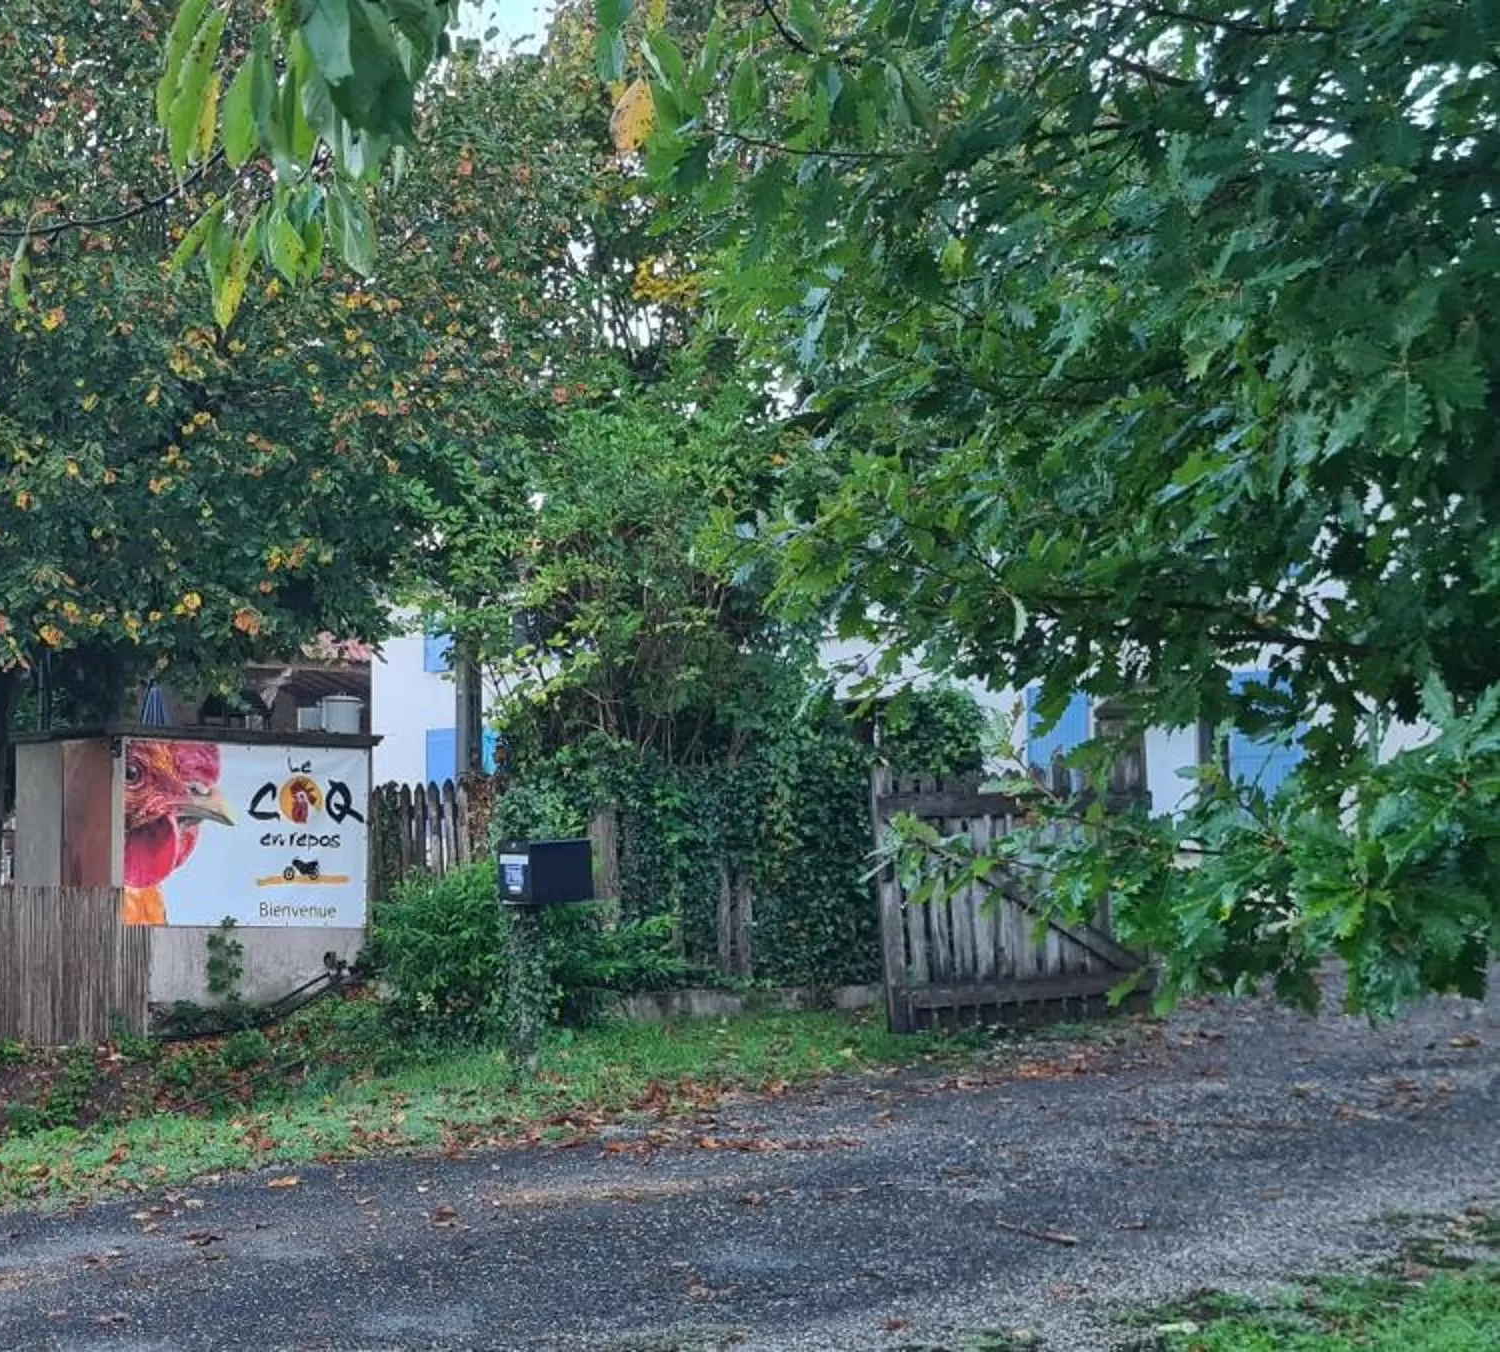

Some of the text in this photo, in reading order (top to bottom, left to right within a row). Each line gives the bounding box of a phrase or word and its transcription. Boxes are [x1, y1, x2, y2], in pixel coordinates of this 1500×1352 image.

[287, 756, 312, 773] Le
[260, 832, 341, 851] en repos
[259, 901, 337, 918] Bienvenue
